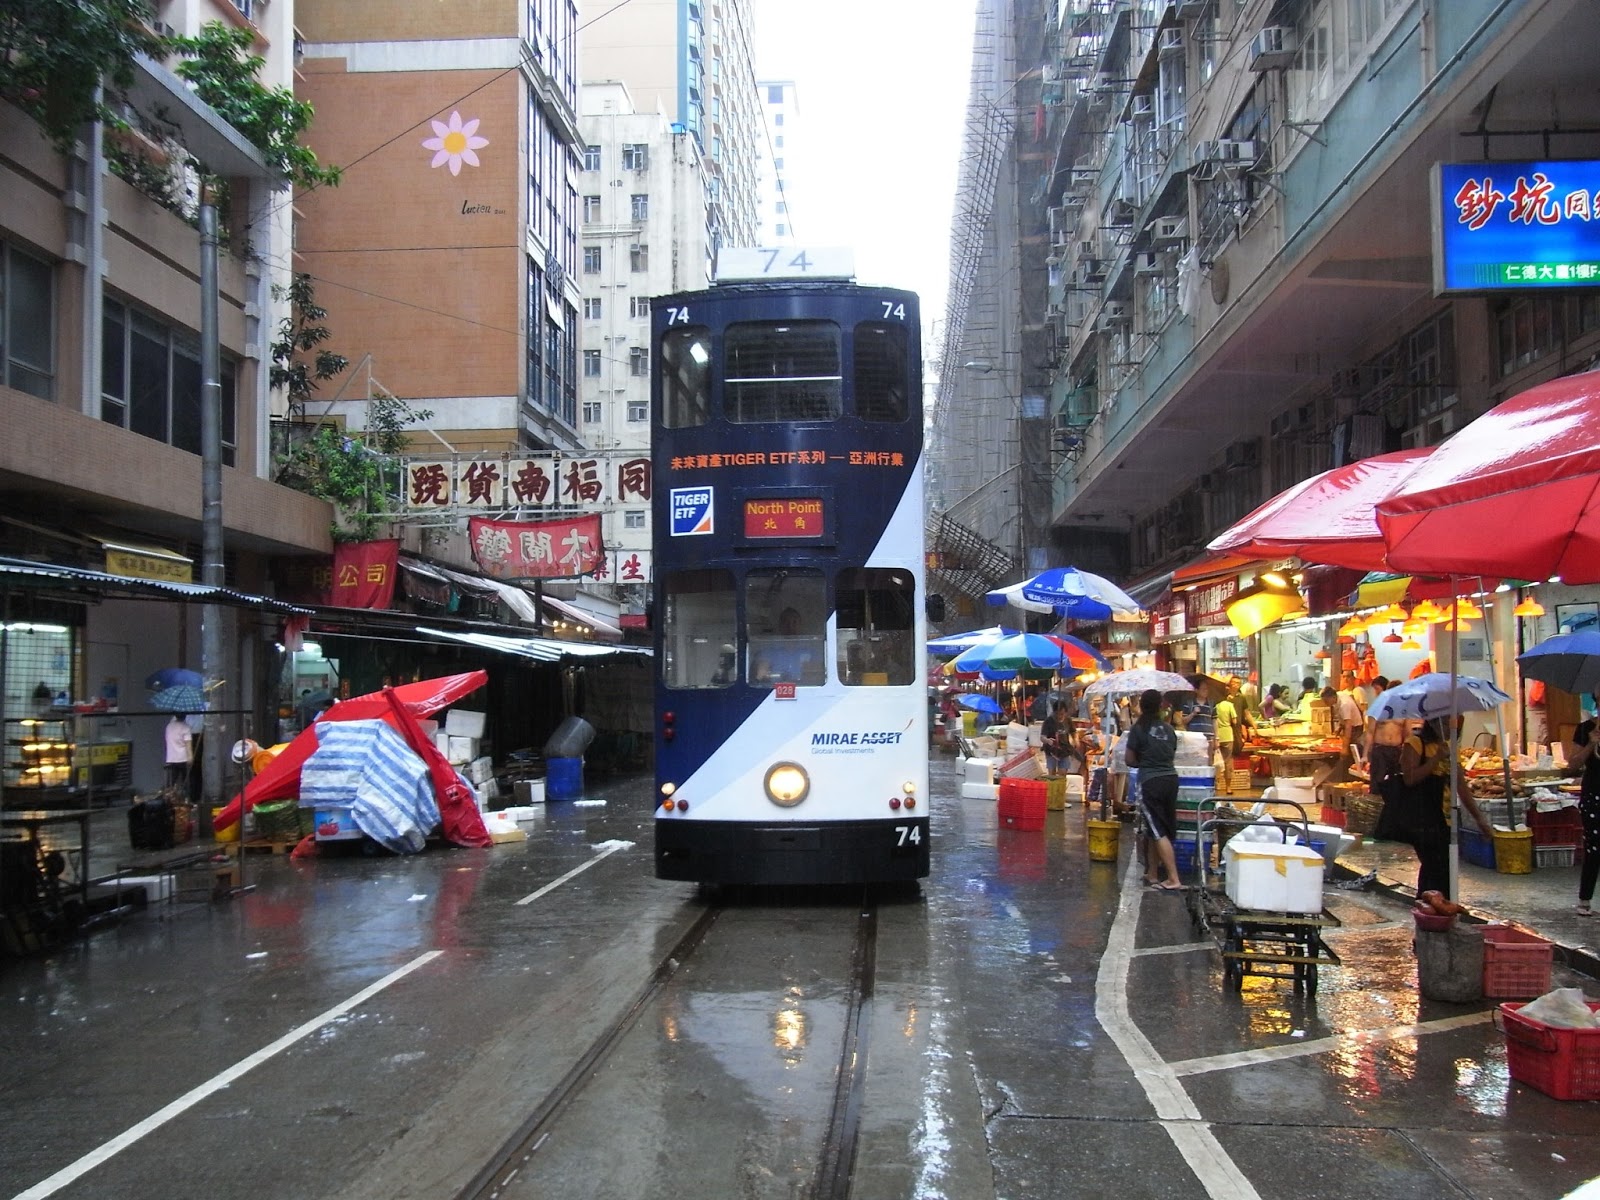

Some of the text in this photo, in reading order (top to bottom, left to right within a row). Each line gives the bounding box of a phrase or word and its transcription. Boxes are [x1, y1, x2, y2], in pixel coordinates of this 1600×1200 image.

[461, 199, 491, 215] Lucien
[757, 249, 813, 273] 74
[667, 306, 690, 326] 74
[881, 301, 906, 321] 74
[671, 452, 766, 470] 未來資產TIGER
[769, 450, 825, 465] ETF系列
[849, 451, 904, 467] 亞洲行業
[674, 492, 709, 507] TIGER
[674, 507, 697, 520] ETF
[747, 500, 822, 516] North Point
[777, 685, 794, 695] 028
[811, 731, 903, 746] MIRAE ASSET
[894, 825, 922, 847] 74
